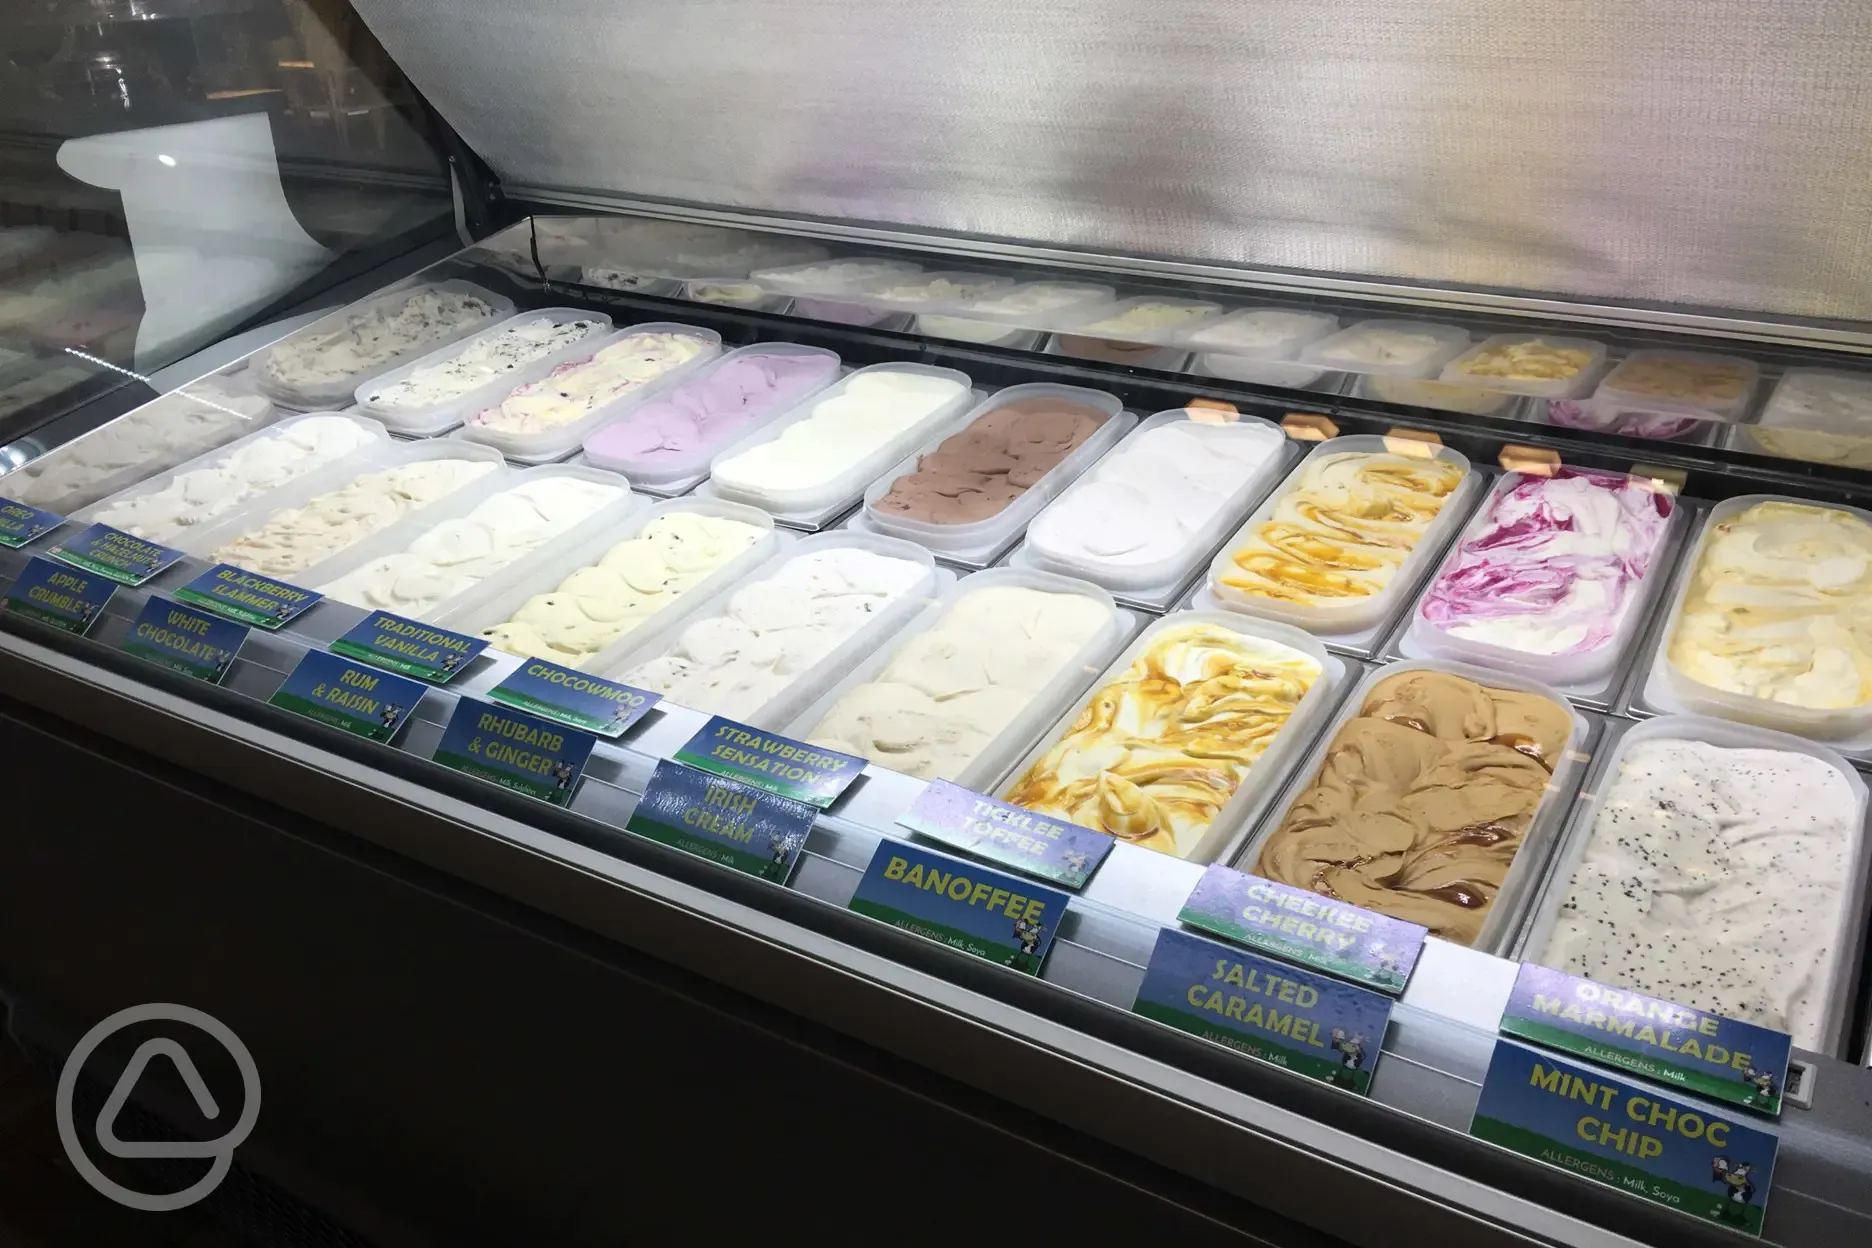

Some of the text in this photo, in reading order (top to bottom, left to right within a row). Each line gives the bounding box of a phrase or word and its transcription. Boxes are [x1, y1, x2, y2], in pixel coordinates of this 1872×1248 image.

[104, 532, 164, 557] CHOCOLATE
[28, 585, 83, 613] CRUMBLE
[47, 571, 88, 593] APPLE
[212, 584, 281, 611] SLAMMER
[216, 569, 309, 603] BLACKBERRY
[167, 609, 212, 636] WHITE
[374, 616, 471, 653] TRADITIONAL
[137, 622, 217, 662] CHOCOLATE
[374, 634, 439, 662] VANILLA
[312, 683, 380, 715] & RAISIN
[340, 669, 380, 691] RUM
[527, 664, 646, 707] CHOCOWMOO
[477, 712, 564, 753] RHUBARB
[715, 724, 849, 773] STRAWBERRY
[467, 735, 553, 777] & GINGER
[711, 744, 822, 785] SENSATION
[704, 784, 757, 817] IRISH
[683, 807, 755, 844] CREAM
[962, 815, 1050, 857] TOFFEE
[884, 856, 1046, 924] BANOFFEE
[1247, 884, 1375, 934] CHEEKEE
[1242, 905, 1358, 952] CHERRY
[966, 943, 987, 957] Soya
[1211, 959, 1320, 1008] SALTED
[1186, 984, 1326, 1048] CARAMEL
[1575, 982, 1721, 1037] ORANGE
[1532, 994, 1753, 1071] MARMALADE
[1268, 1051, 1288, 1066] Milk
[1663, 1068, 1687, 1082] Milk
[1529, 1063, 1731, 1148] MINT CHOC
[1576, 1115, 1664, 1160] CHIP
[1623, 1175, 1649, 1194] Milk,
[1652, 1185, 1680, 1204] Soya
